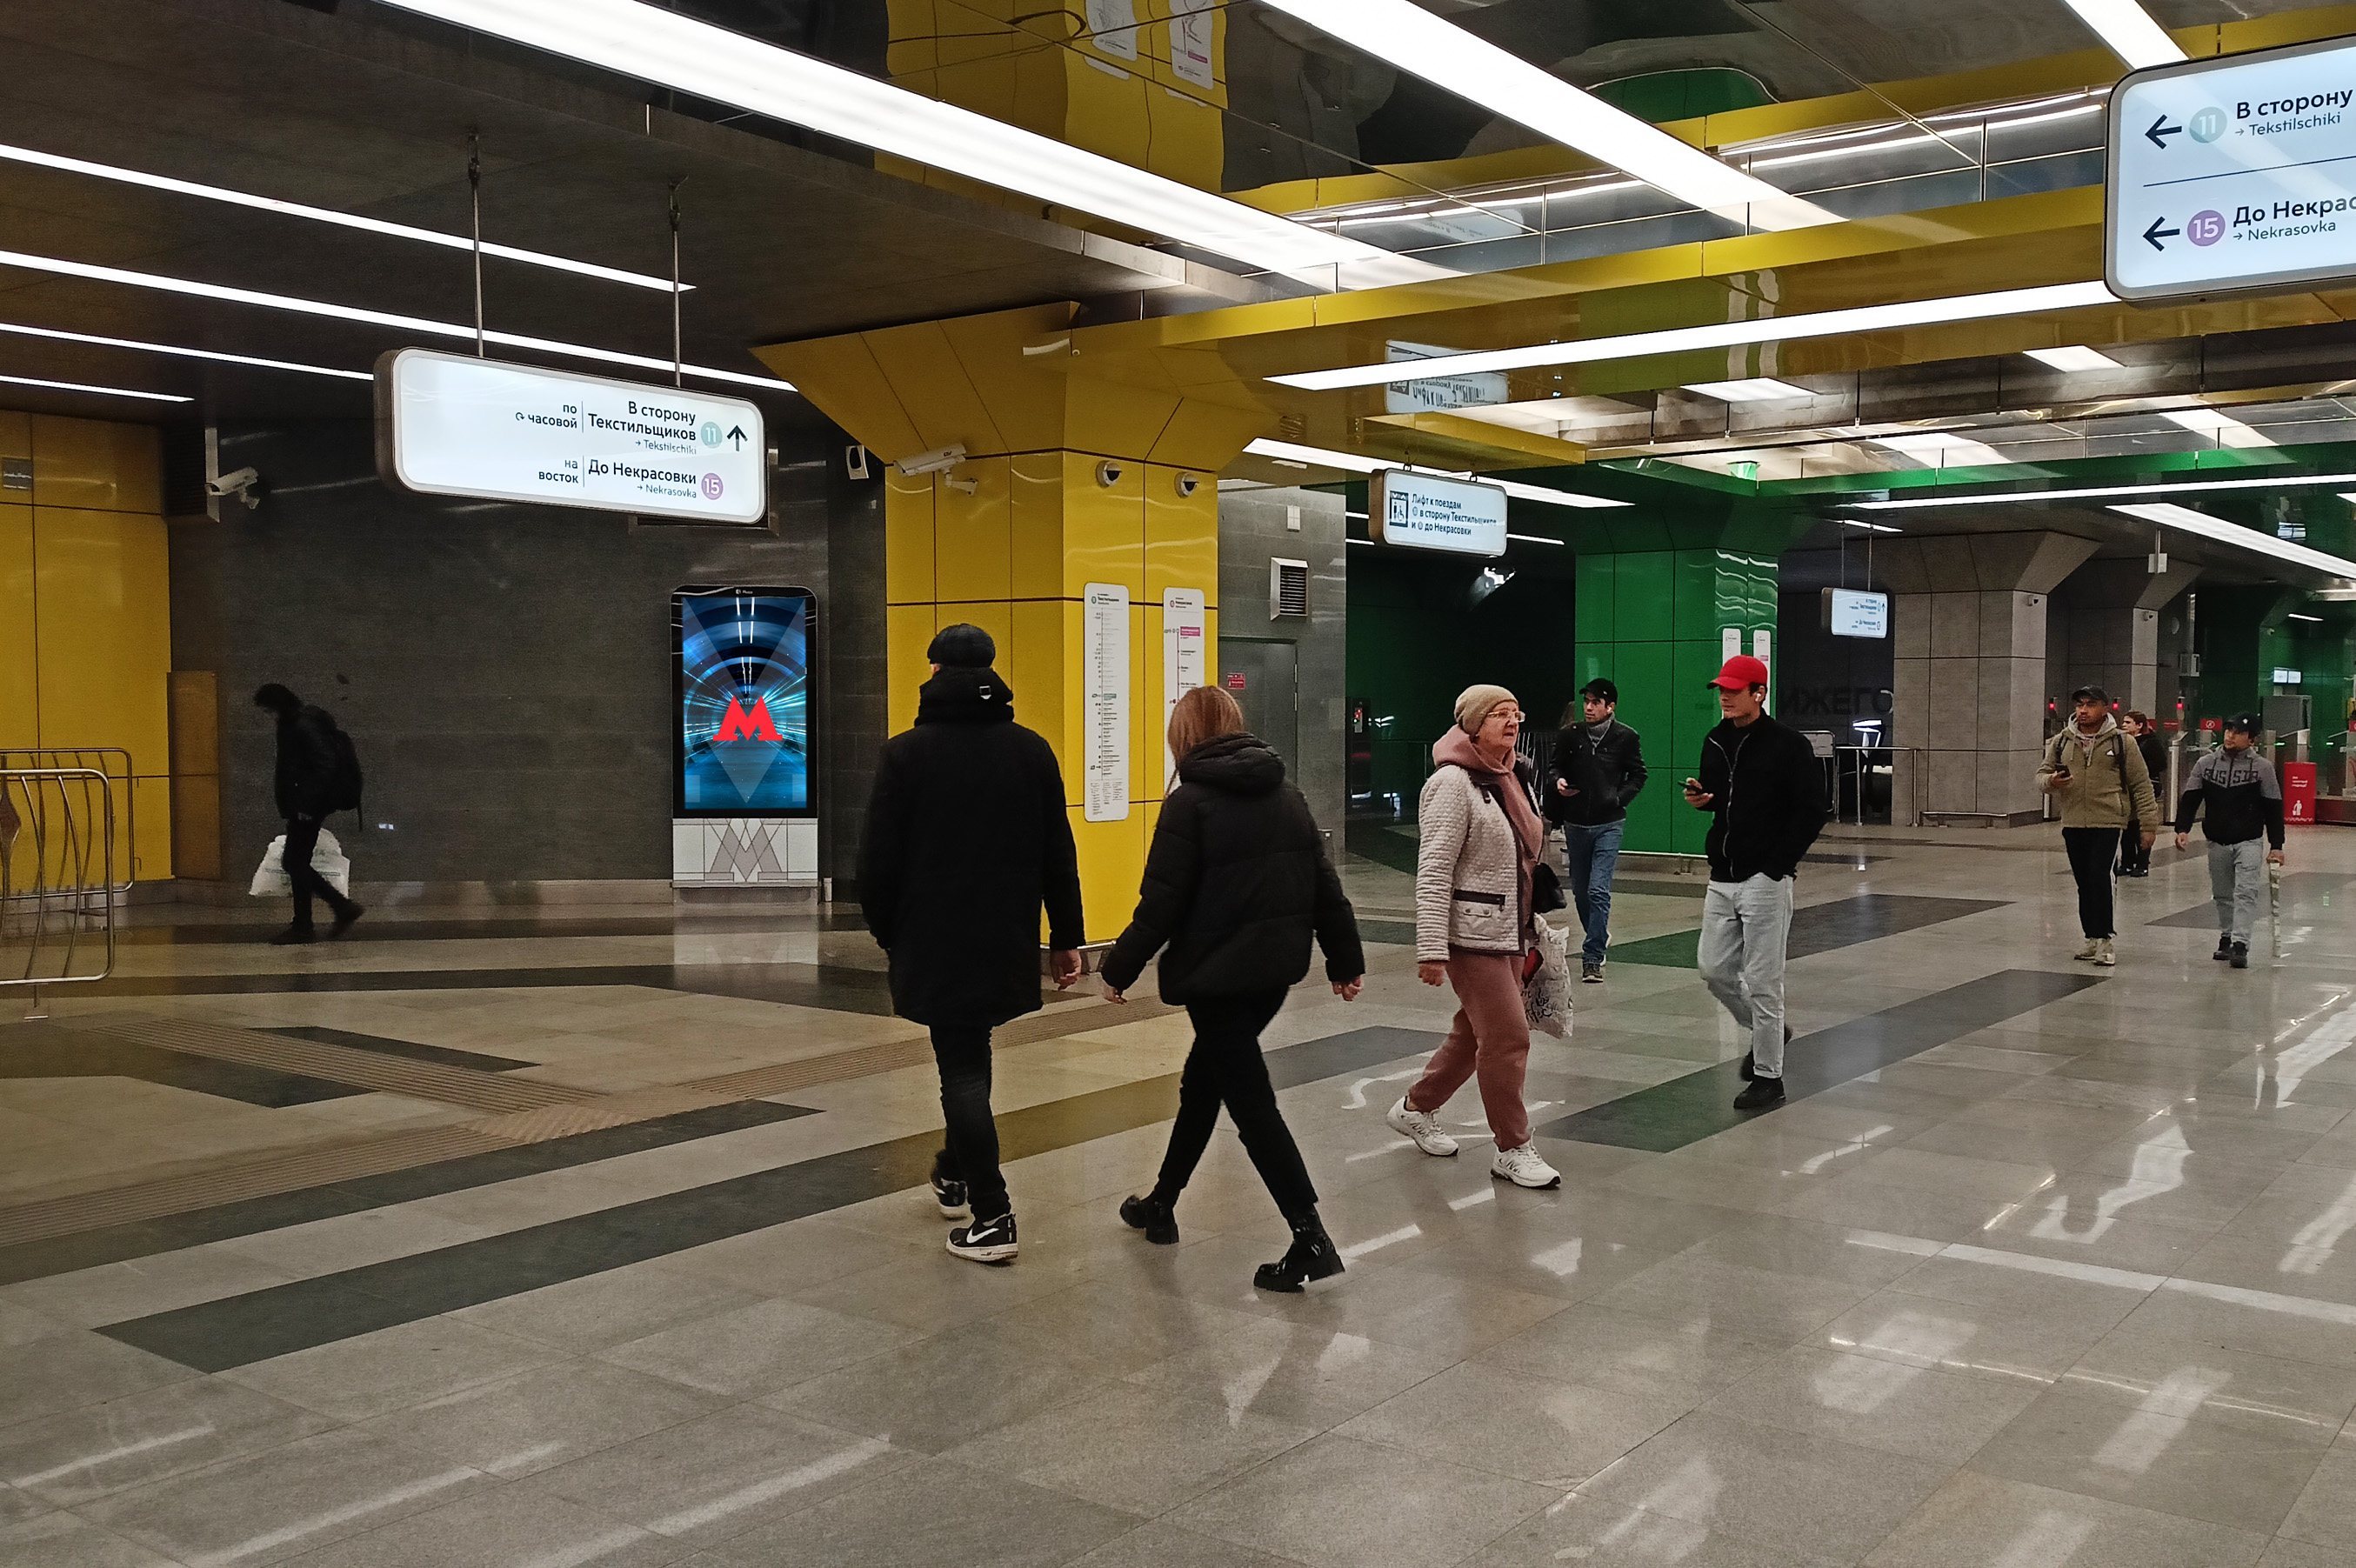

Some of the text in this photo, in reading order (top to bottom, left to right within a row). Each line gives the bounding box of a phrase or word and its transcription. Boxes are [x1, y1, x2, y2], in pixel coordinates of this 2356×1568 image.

[2236, 89, 2353, 119] В сторону
[2199, 114, 2217, 136] 11
[2249, 111, 2341, 137] Tekstilschiki
[2233, 205, 2266, 228] До
[2192, 217, 2219, 239] 15
[2248, 220, 2336, 241] Nekrasovka
[563, 404, 577, 416] по
[628, 400, 696, 426] В сторону
[527, 412, 577, 430] часовой
[588, 413, 697, 440] Текстильщиков
[705, 425, 717, 444] 11
[644, 438, 697, 455] Tekstilschiki
[564, 458, 578, 470] на
[588, 459, 697, 485] До Некрасовки
[538, 470, 579, 484] восток
[645, 484, 697, 499] Nekrasovka
[704, 479, 720, 495] 15
[1412, 493, 1429, 506] Лифт
[1435, 498, 1462, 510] поездам
[1425, 510, 1451, 522] сторону
[1425, 523, 1433, 531] до
[1434, 523, 1472, 536] Некрасовки
